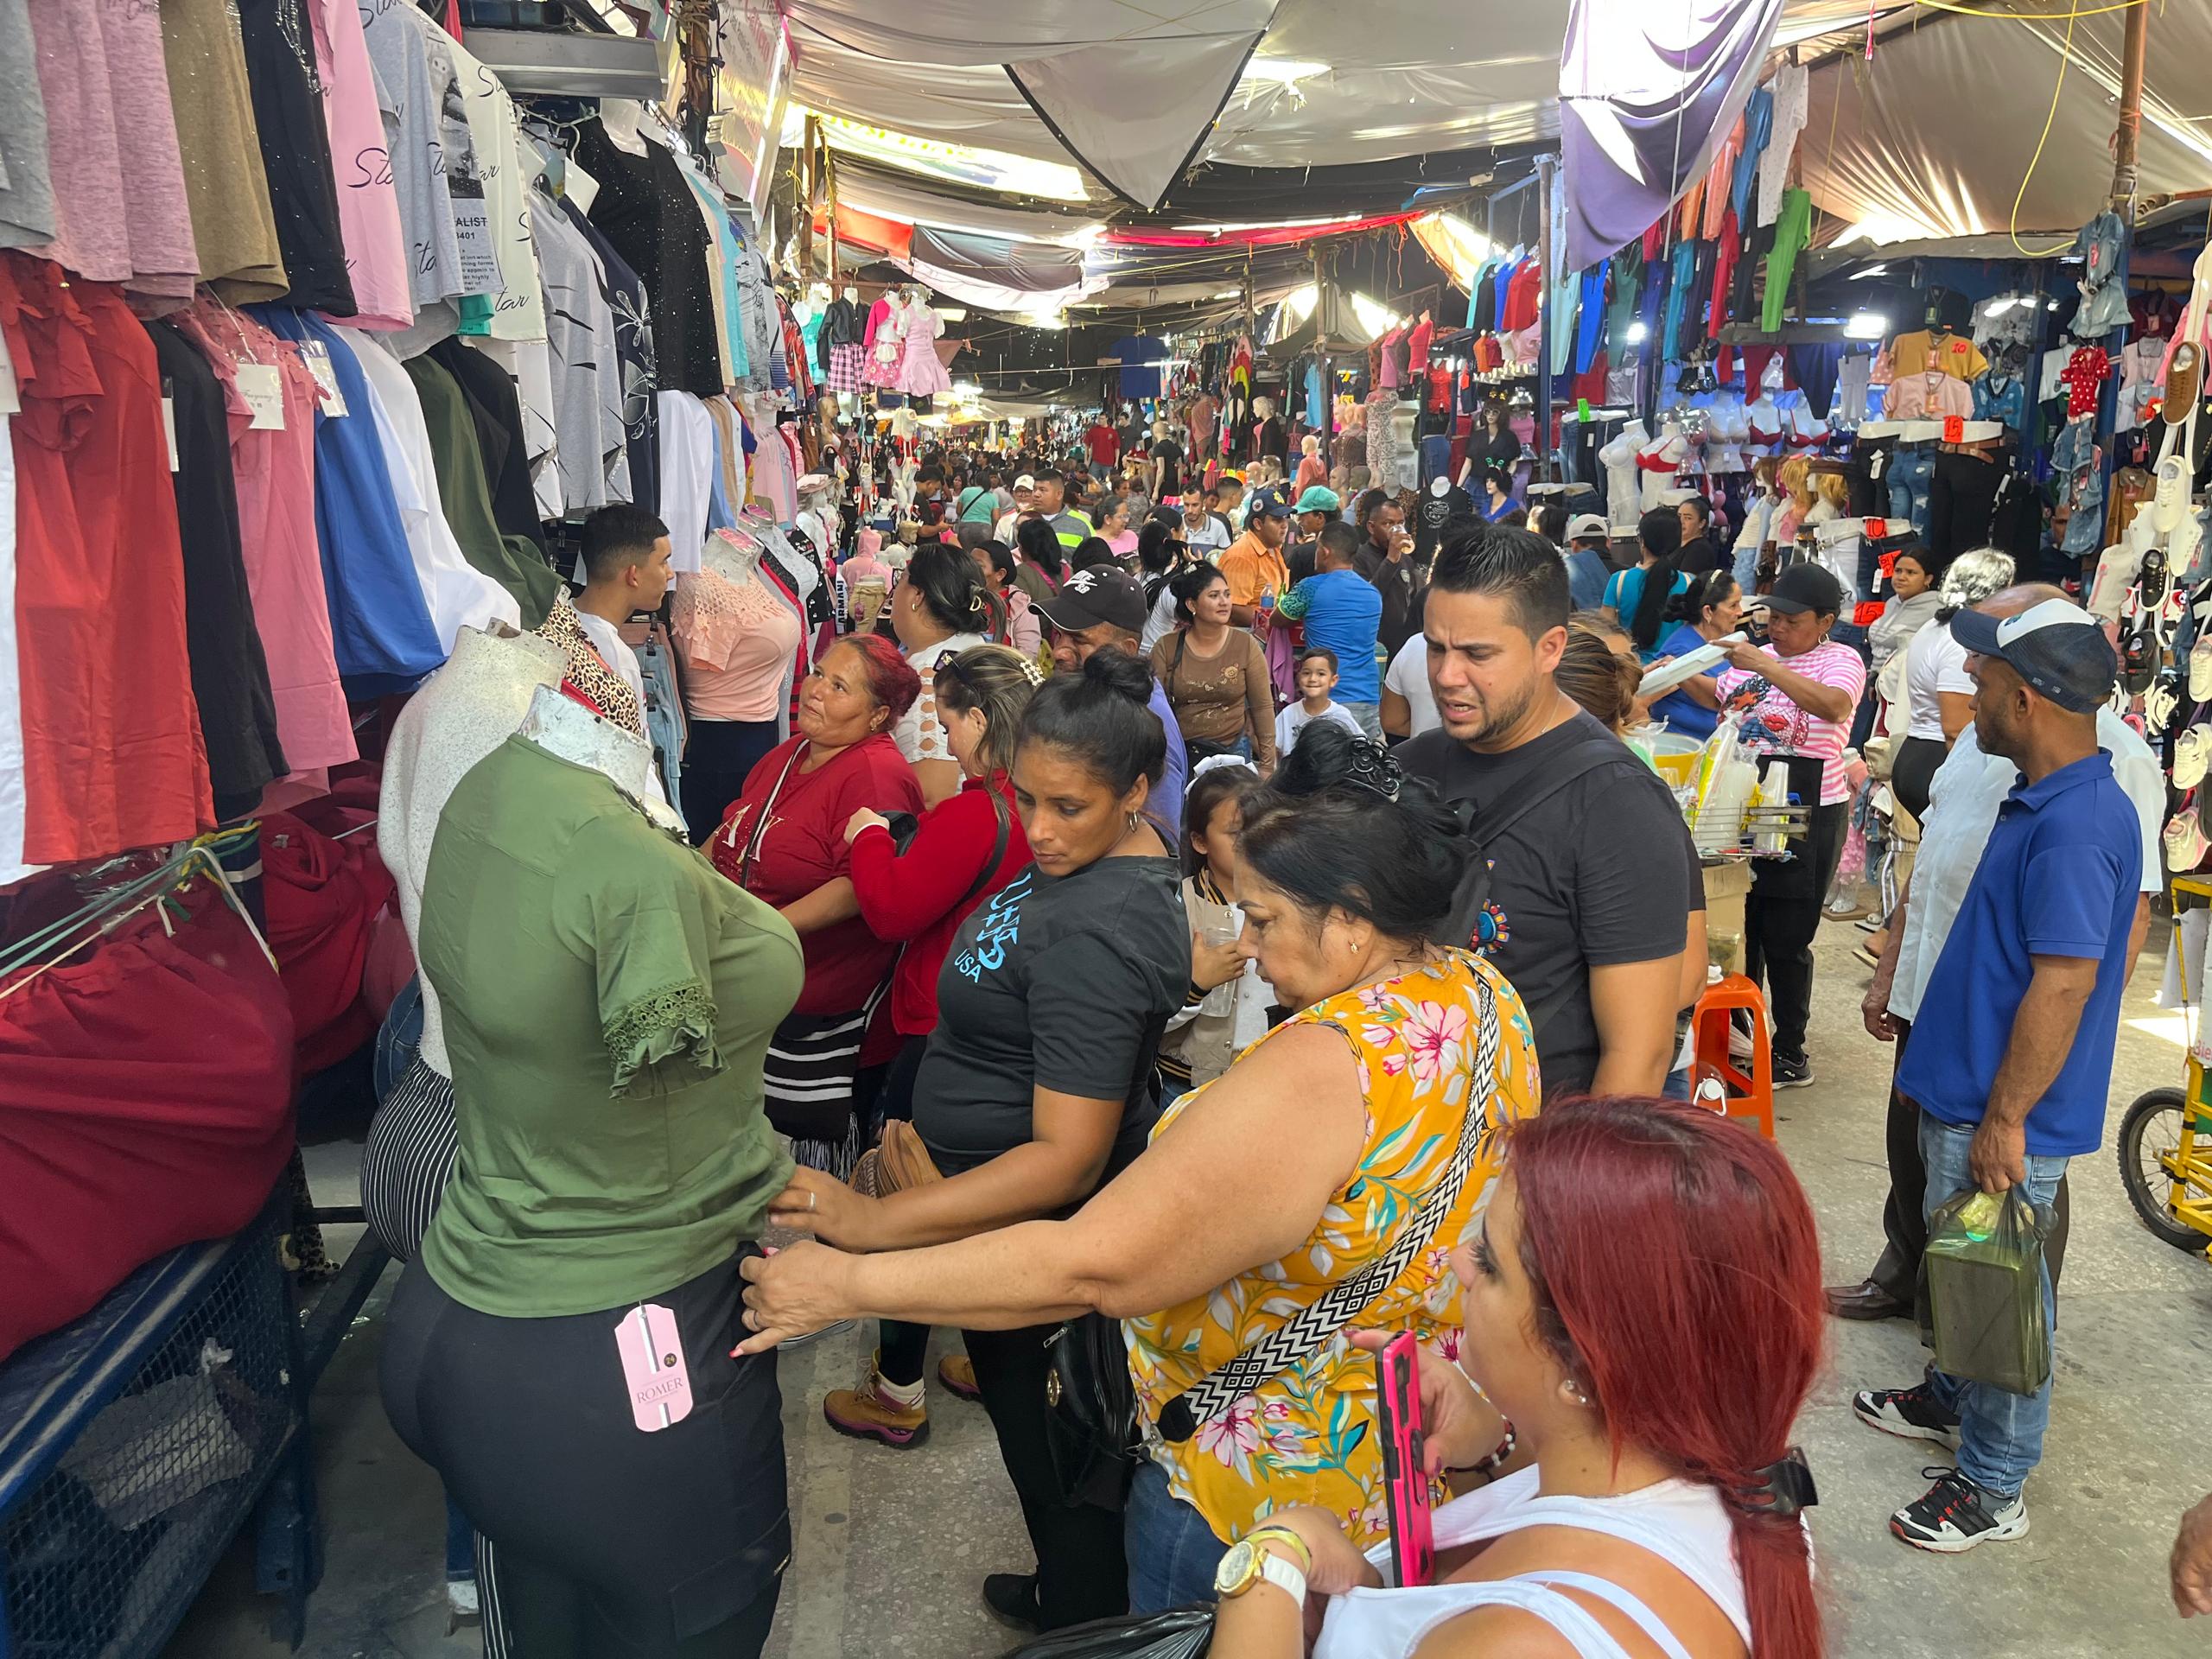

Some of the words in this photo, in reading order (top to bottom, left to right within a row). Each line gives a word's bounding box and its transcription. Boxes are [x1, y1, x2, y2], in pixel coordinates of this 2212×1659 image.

[455, 217, 487, 226] ALIST
[836, 581, 845, 623] ARMANI
[954, 948, 982, 983] USA
[636, 1377, 683, 1404] ROMER
